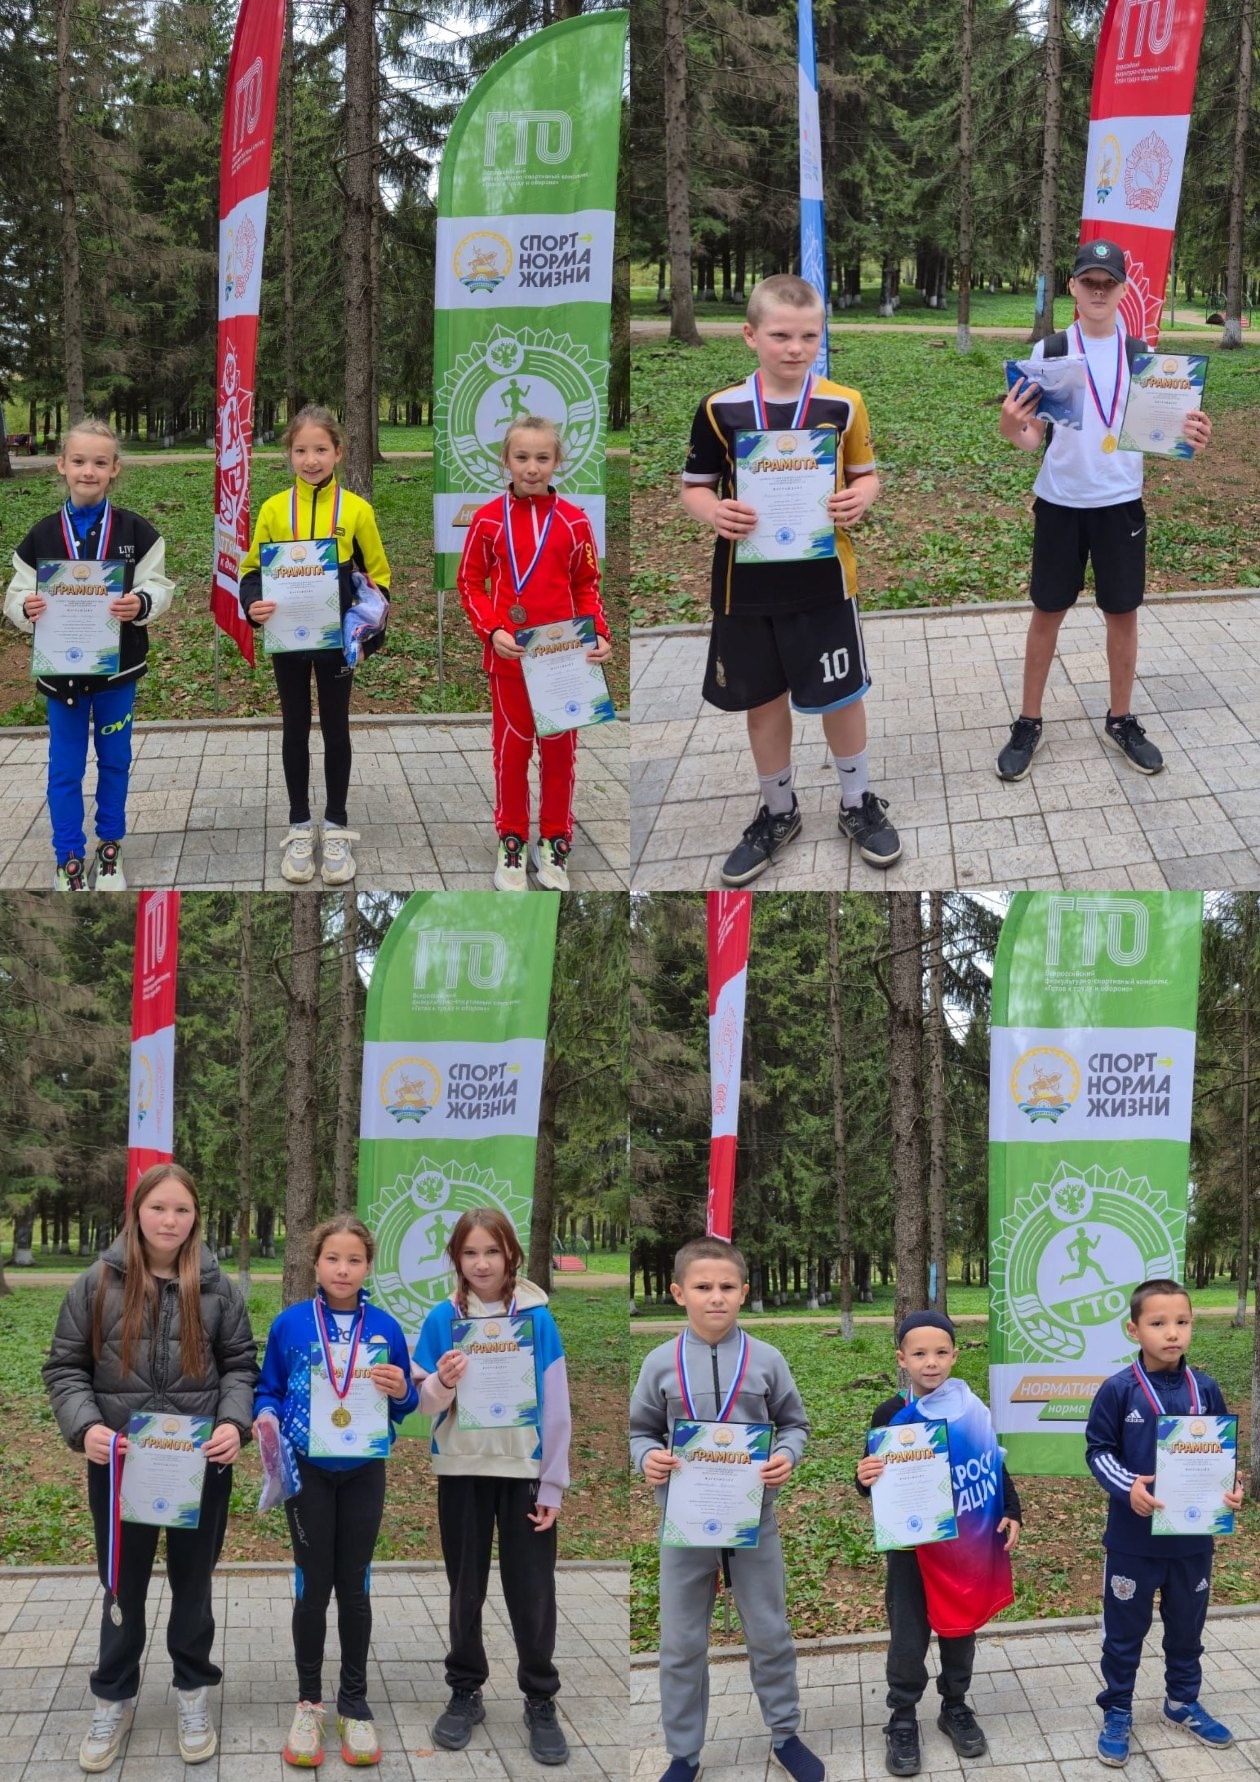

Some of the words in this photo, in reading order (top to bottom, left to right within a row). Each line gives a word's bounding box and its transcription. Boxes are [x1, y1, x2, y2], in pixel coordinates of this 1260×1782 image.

[484, 110, 573, 166] ГТО
[520, 232, 579, 251] СПОРТ
[519, 248, 591, 270] НОРМА
[518, 266, 590, 287] ЖИЗНИ
[1143, 377, 1191, 390] ГРАМОТА
[754, 458, 818, 472] ГРАМОТА
[274, 565, 325, 578] ГРАМОТА
[53, 583, 108, 596] ГРАМОТА
[532, 640, 583, 658] ГРАМОТА
[819, 647, 849, 683] 10
[1046, 896, 1149, 966] ГТО
[413, 930, 506, 989] ГТО
[449, 1062, 507, 1081] СПОРТ
[1088, 1052, 1158, 1073] СПОРТ
[447, 1079, 518, 1100] НОРМА
[1087, 1075, 1171, 1095] НОРМА
[445, 1098, 517, 1119] ЖИЗНИ
[1086, 1096, 1170, 1117] ЖИЗНИ
[1070, 1291, 1126, 1323] ГТО
[468, 1341, 520, 1354] ГРАМОТА
[1048, 1404, 1086, 1416] норма
[142, 1438, 194, 1452] ГРАМОТА
[1171, 1442, 1223, 1453] ГРАМОТА
[690, 1449, 752, 1464] ГРАМОТА
[883, 1448, 935, 1464] ГРАМОТА
